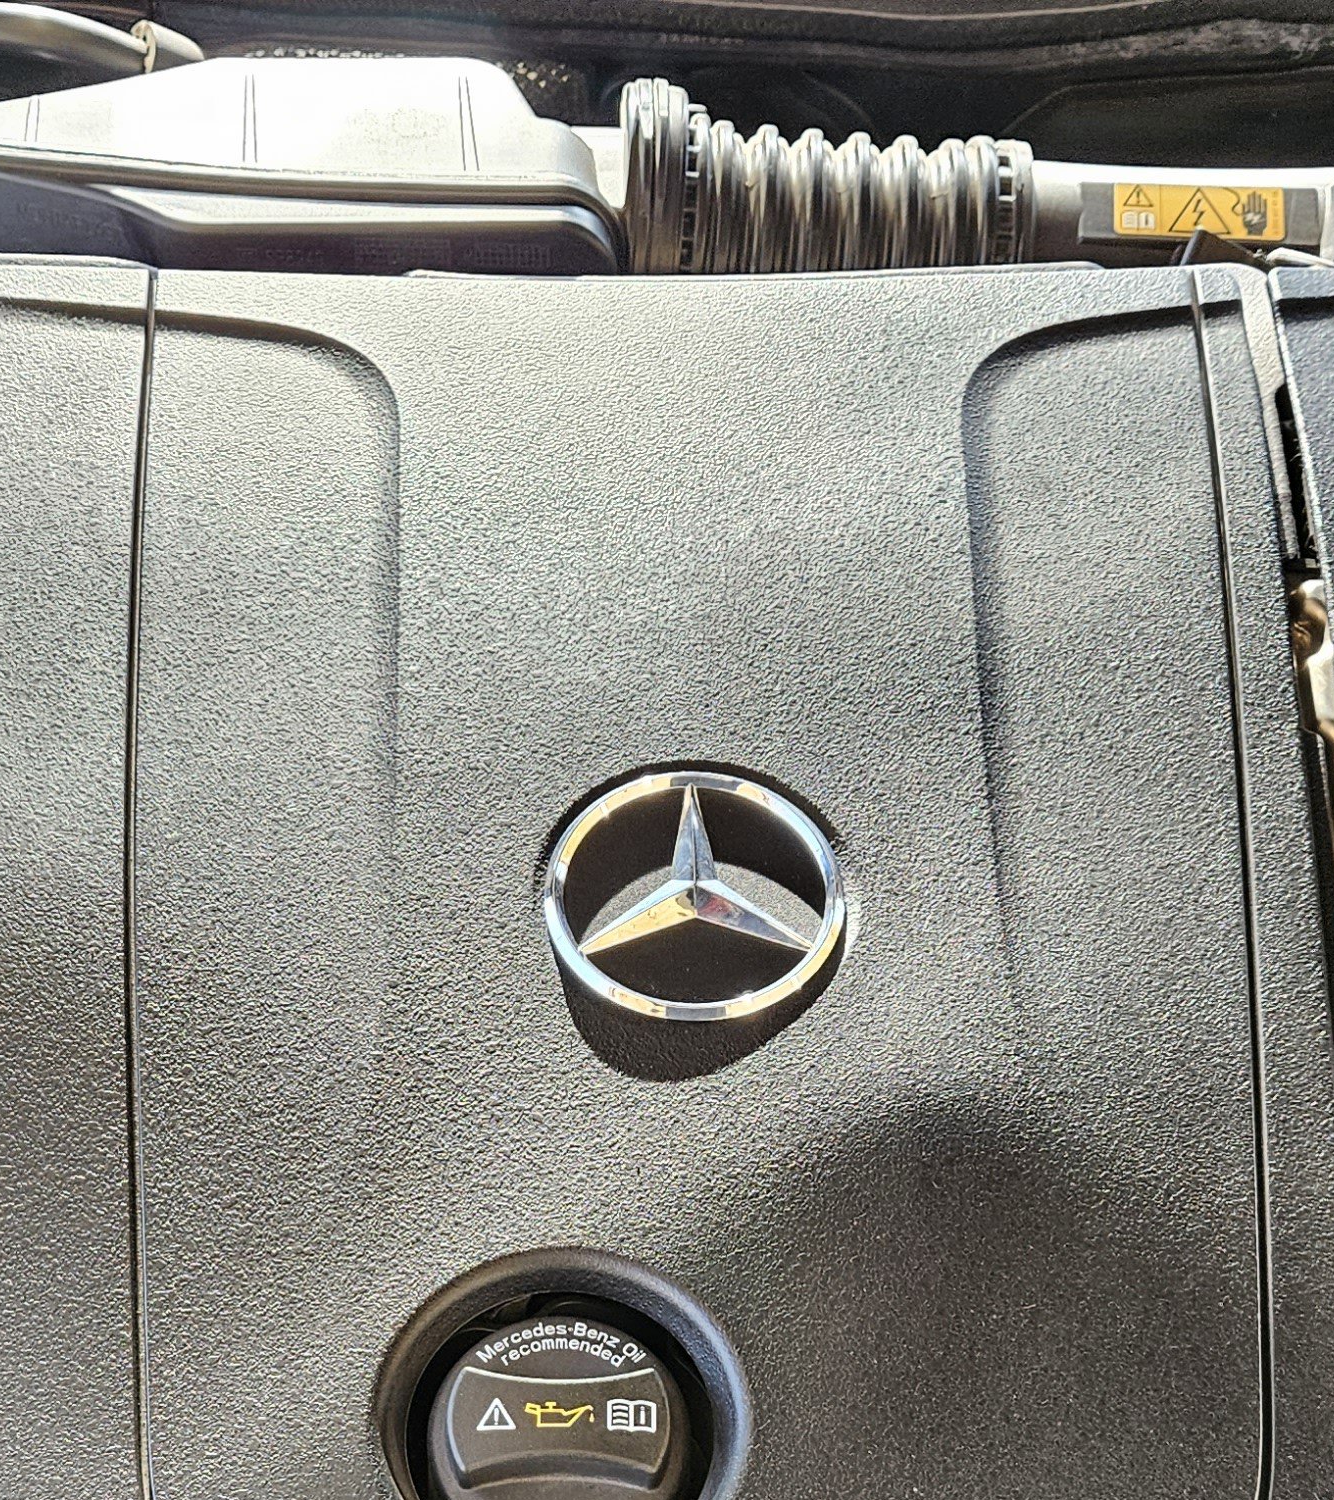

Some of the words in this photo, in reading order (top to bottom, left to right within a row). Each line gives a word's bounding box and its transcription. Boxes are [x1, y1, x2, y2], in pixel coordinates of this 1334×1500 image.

[476, 1322, 620, 1364] Mercedes-Benz
[622, 1342, 646, 1364] Oil
[500, 1337, 627, 1367] recommended
